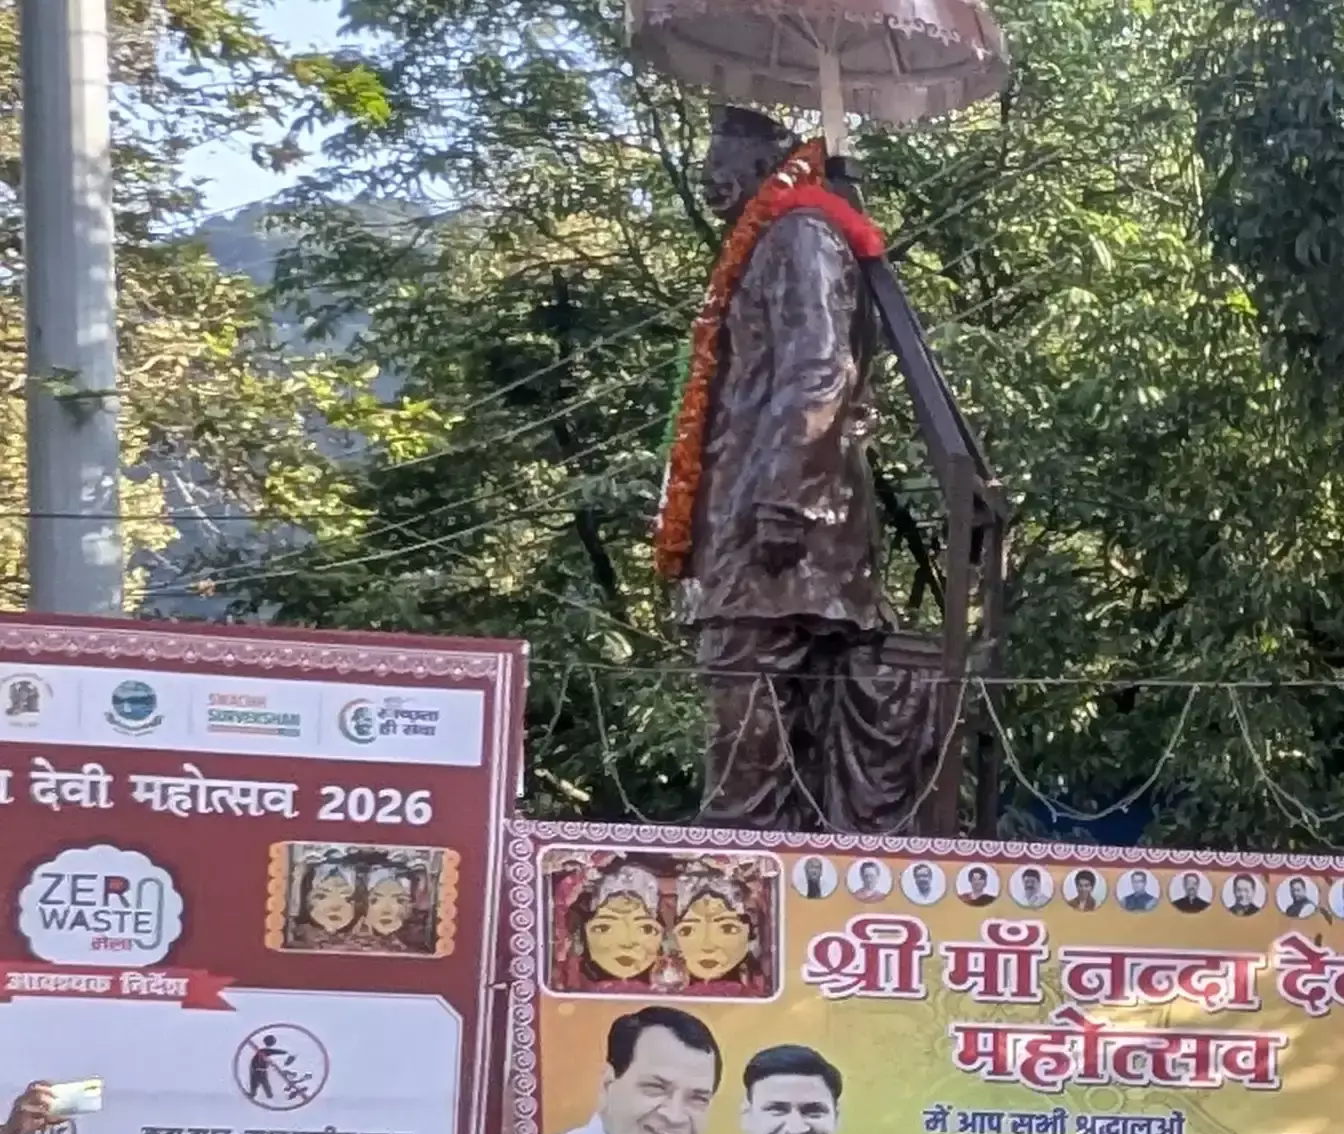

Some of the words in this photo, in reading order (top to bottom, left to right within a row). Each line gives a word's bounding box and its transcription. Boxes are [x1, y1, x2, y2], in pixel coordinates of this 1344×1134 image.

[29, 757, 114, 811] देवी
[128, 763, 300, 818] महोत्सव
[317, 786, 433, 825] 2026
[39, 907, 153, 934] WASTE
[804, 915, 929, 998] श्री
[1060, 947, 1265, 1010] नन्दा
[950, 1003, 1287, 1092] महोत्सव
[922, 1103, 953, 1133] में
[956, 1111, 1004, 1134] आप
